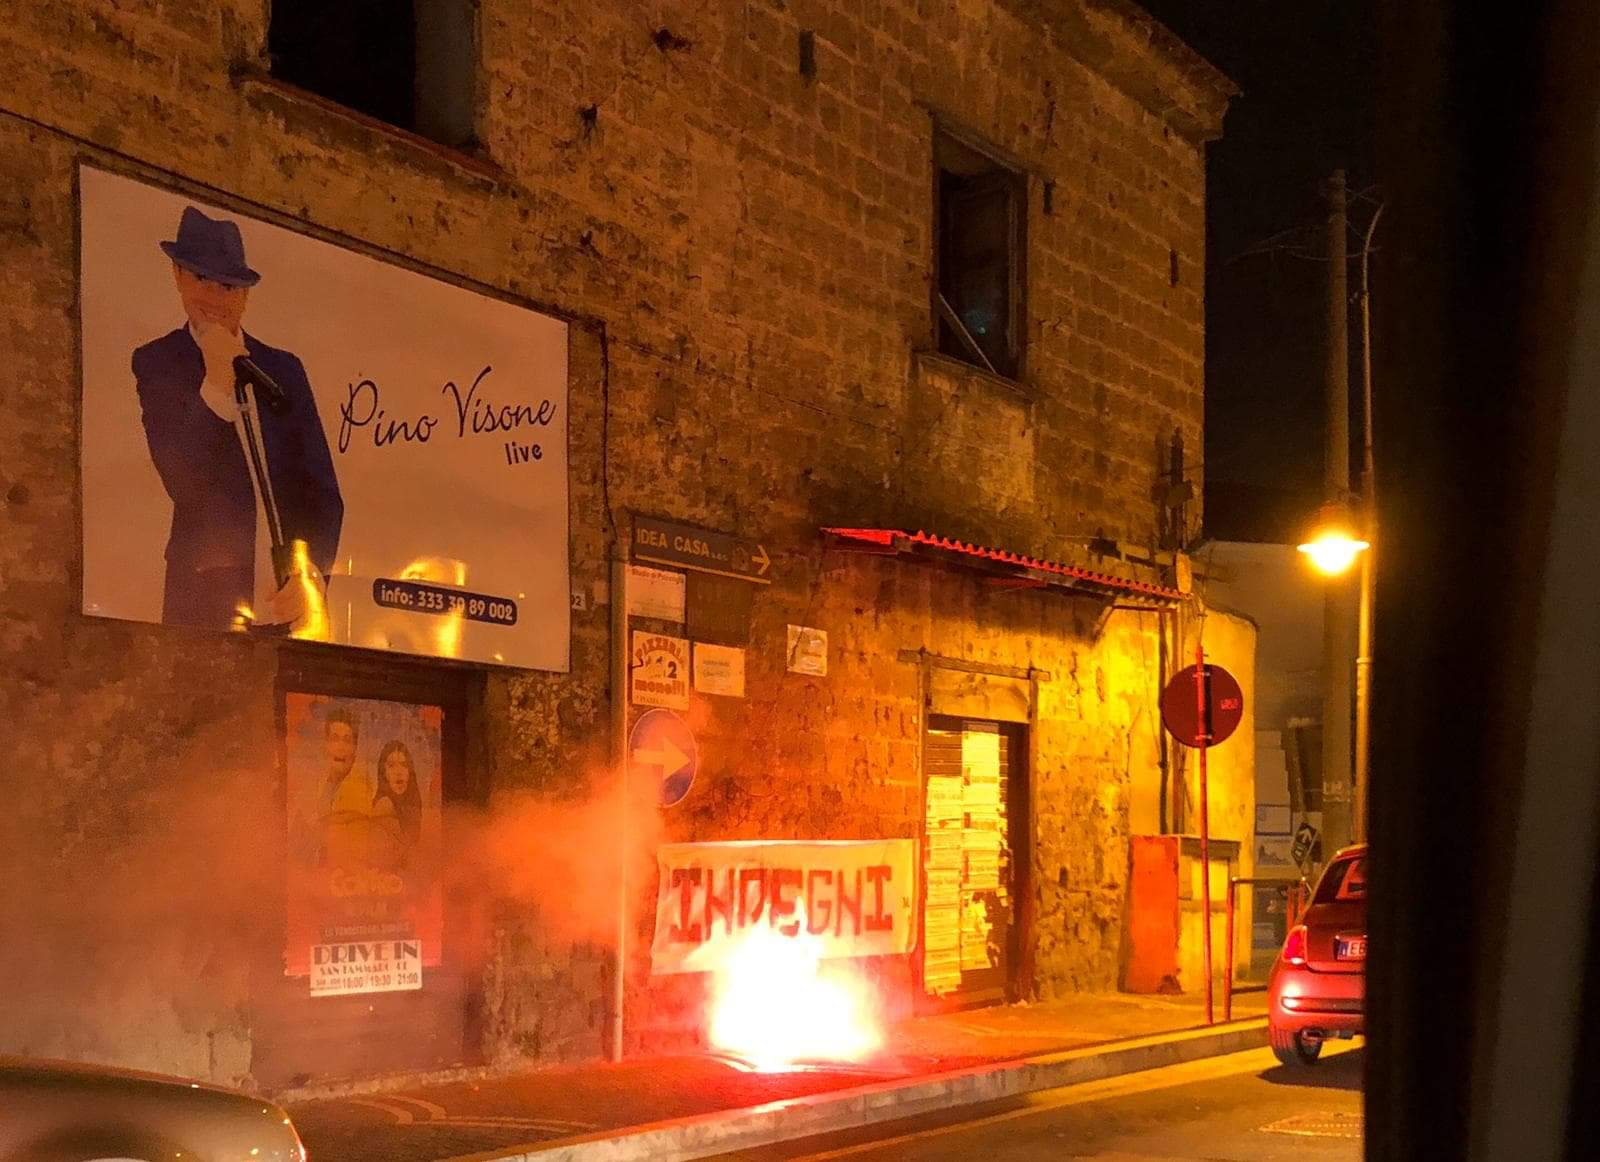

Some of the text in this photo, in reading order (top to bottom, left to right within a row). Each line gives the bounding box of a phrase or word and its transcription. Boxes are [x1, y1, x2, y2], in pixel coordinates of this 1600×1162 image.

[339, 366, 557, 454] Pino Visone
[505, 442, 543, 465] live
[636, 528, 668, 549] IDEA
[674, 536, 709, 558] CASA
[381, 584, 413, 605] info:
[418, 590, 444, 609] 333
[469, 599, 485, 616] 89
[489, 602, 513, 620] 002
[667, 660, 678, 679] 2
[668, 864, 893, 943] INDEGNI
[314, 941, 418, 966] DRIVE IN
